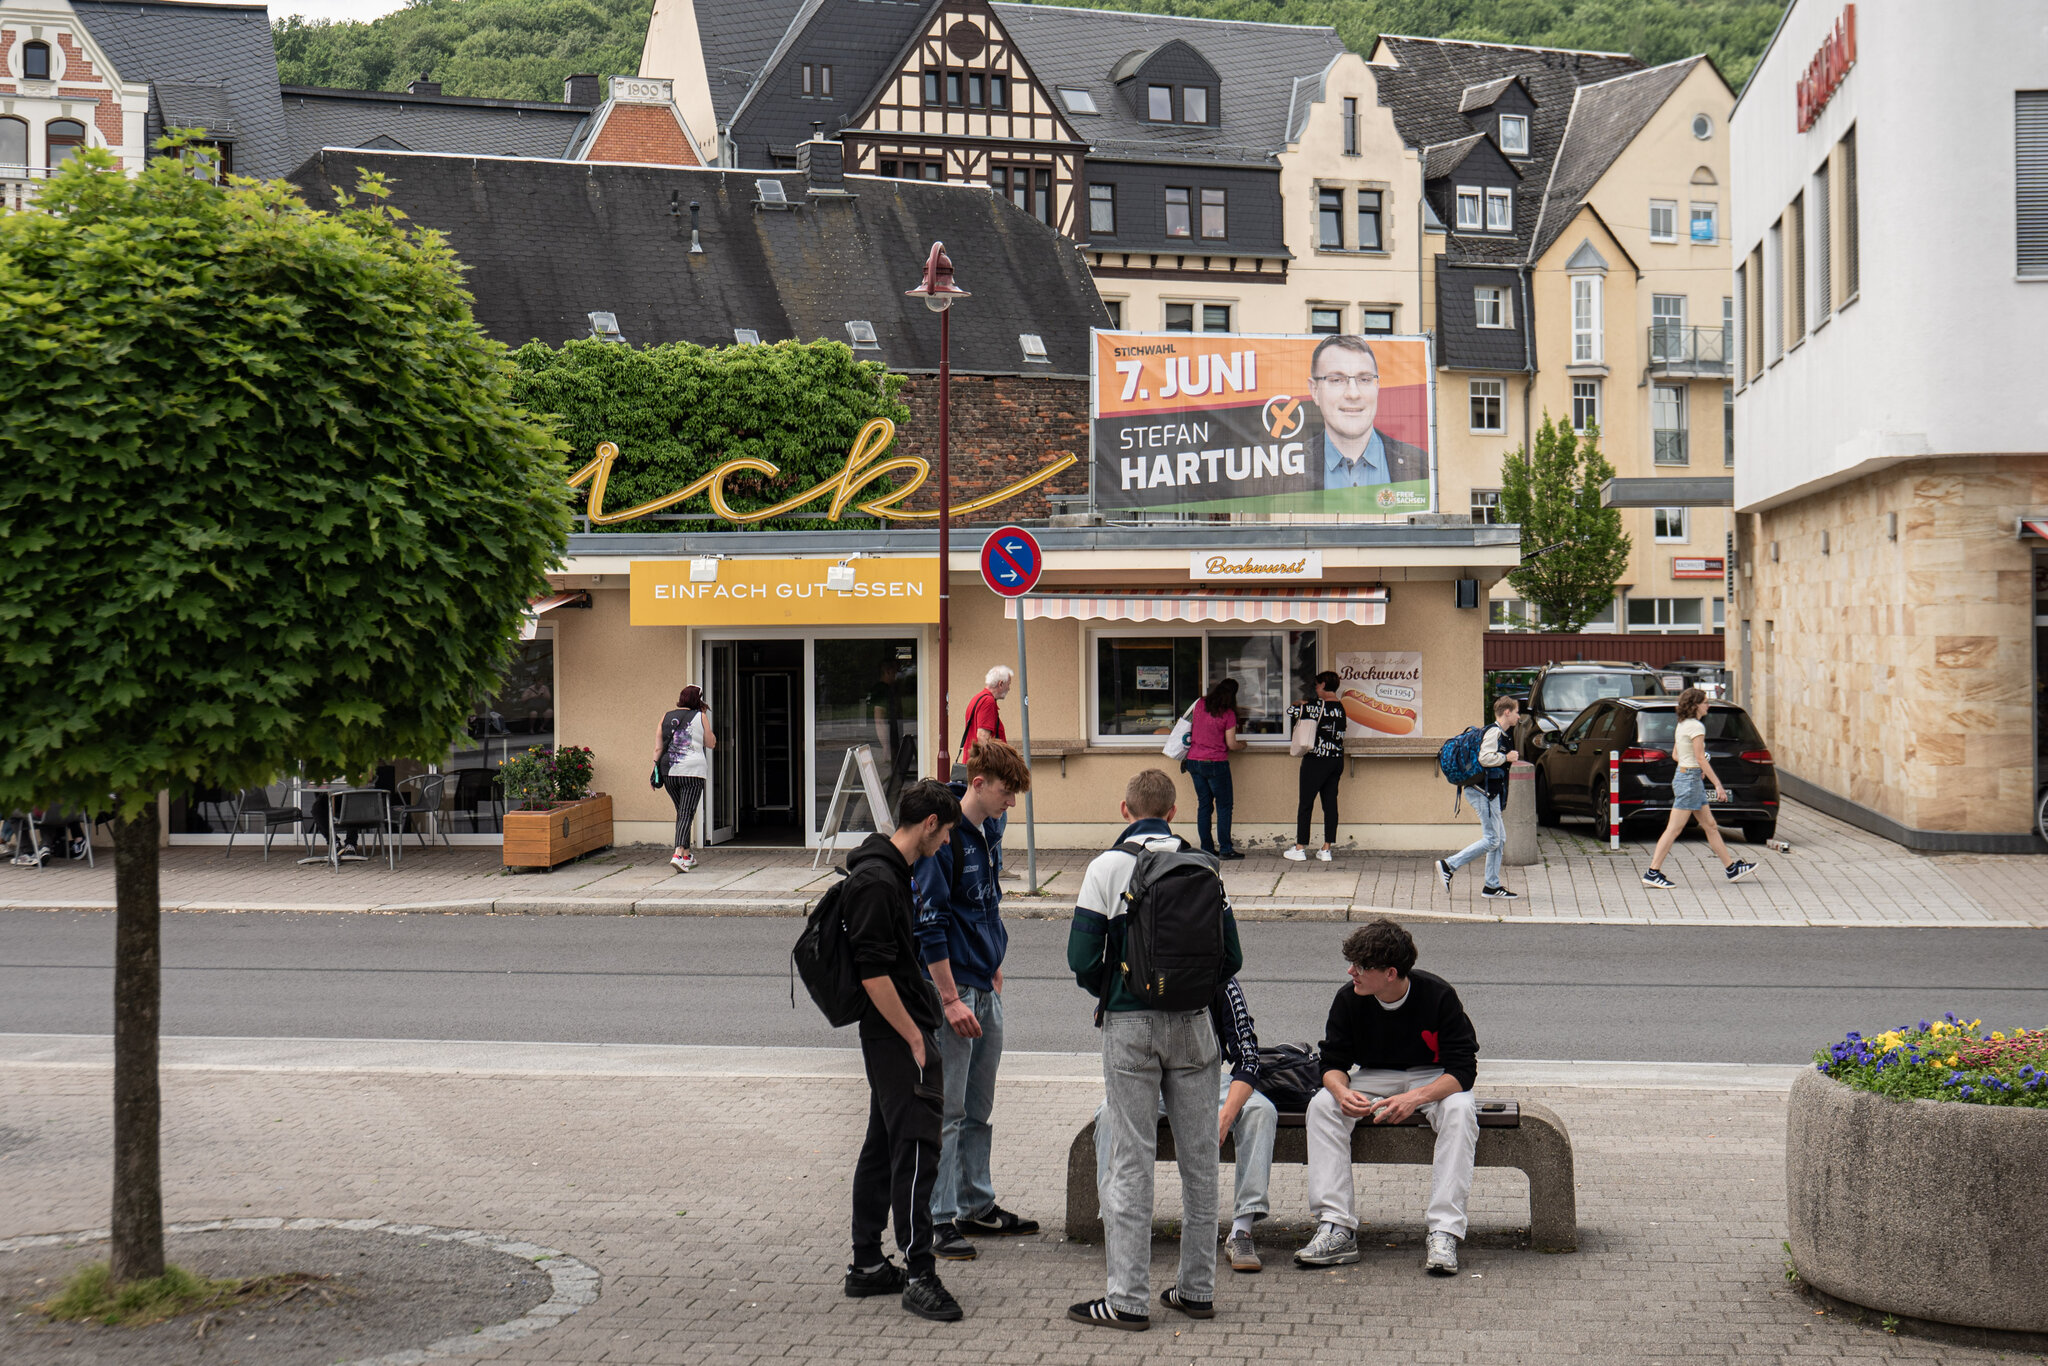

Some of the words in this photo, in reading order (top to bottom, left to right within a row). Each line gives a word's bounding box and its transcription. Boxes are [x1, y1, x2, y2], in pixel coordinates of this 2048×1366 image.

[627, 83, 659, 96] 1900
[1114, 343, 1177, 357] STICHWAHL
[1115, 360, 1149, 402] 7.
[1159, 350, 1257, 399] JUNI
[1119, 420, 1209, 450] STEFAN
[1120, 442, 1306, 491] HARTUNG
[1205, 555, 1307, 575] Bockwurst
[655, 584, 767, 599] EINFACH
[775, 583, 828, 598] GUT
[1339, 665, 1420, 680] Bockwurst
[1379, 688, 1393, 696] seit
[1394, 689, 1412, 698] 1954
